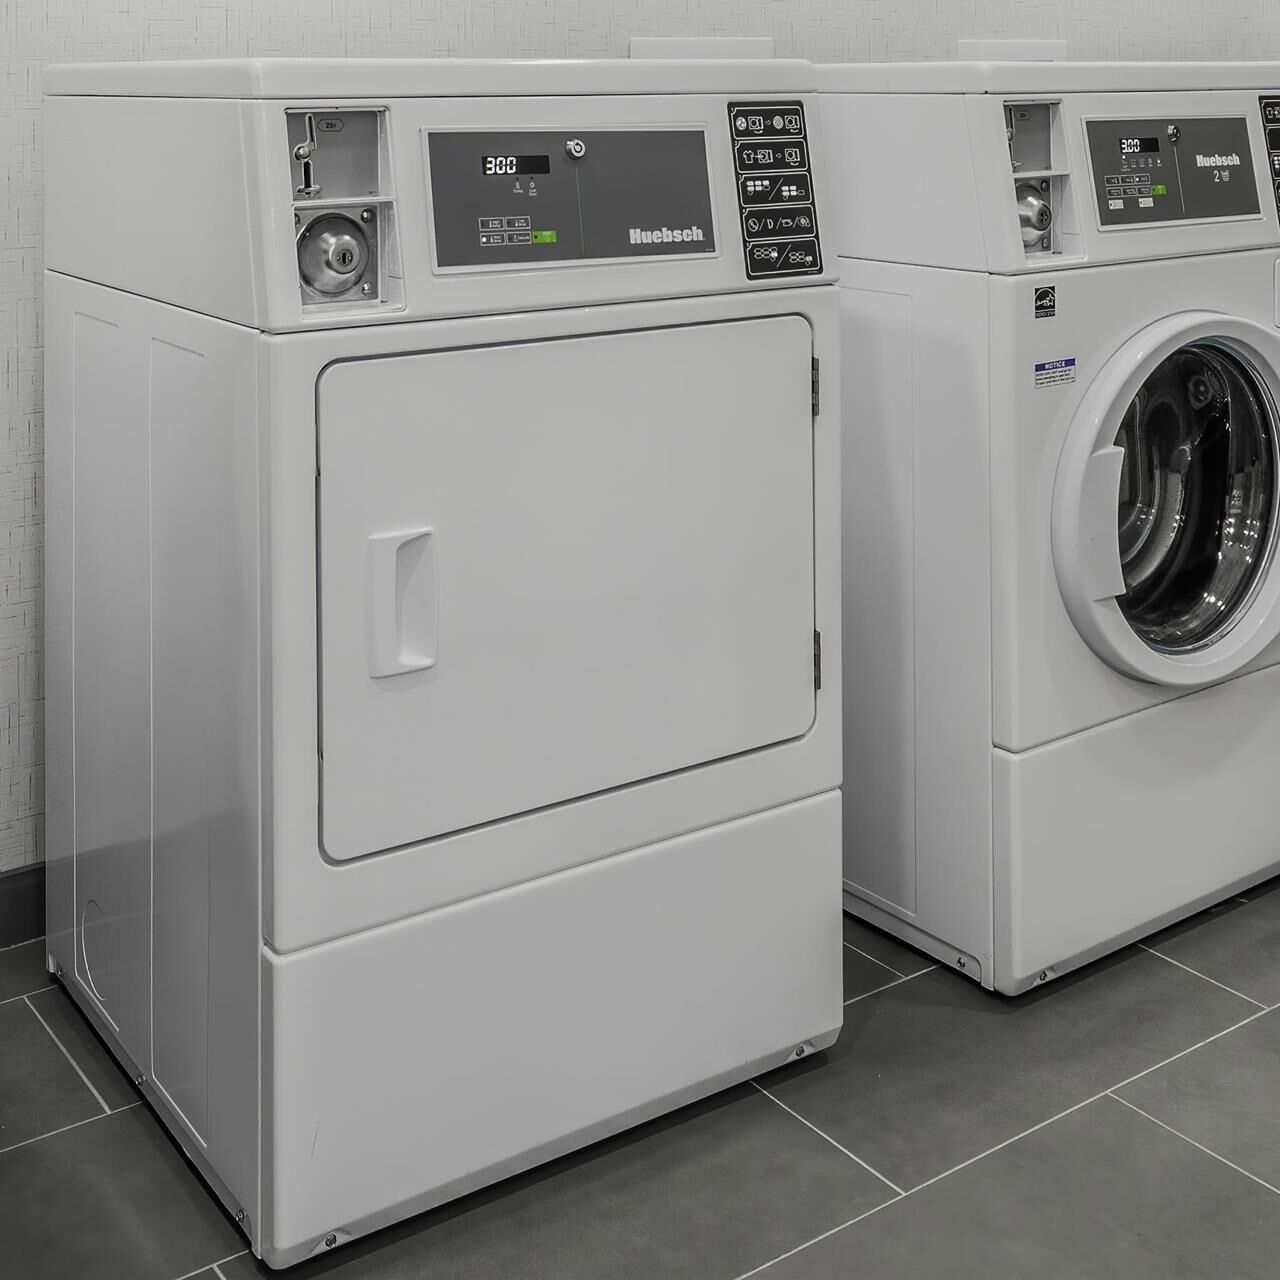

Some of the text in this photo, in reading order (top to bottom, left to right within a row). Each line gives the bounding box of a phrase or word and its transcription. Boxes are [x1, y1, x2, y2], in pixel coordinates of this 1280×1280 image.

[1196, 153, 1241, 167] Huebsch
[1213, 170, 1220, 182] 2
[629, 225, 704, 244] Huebsch
[1045, 360, 1066, 370] NOTICE
